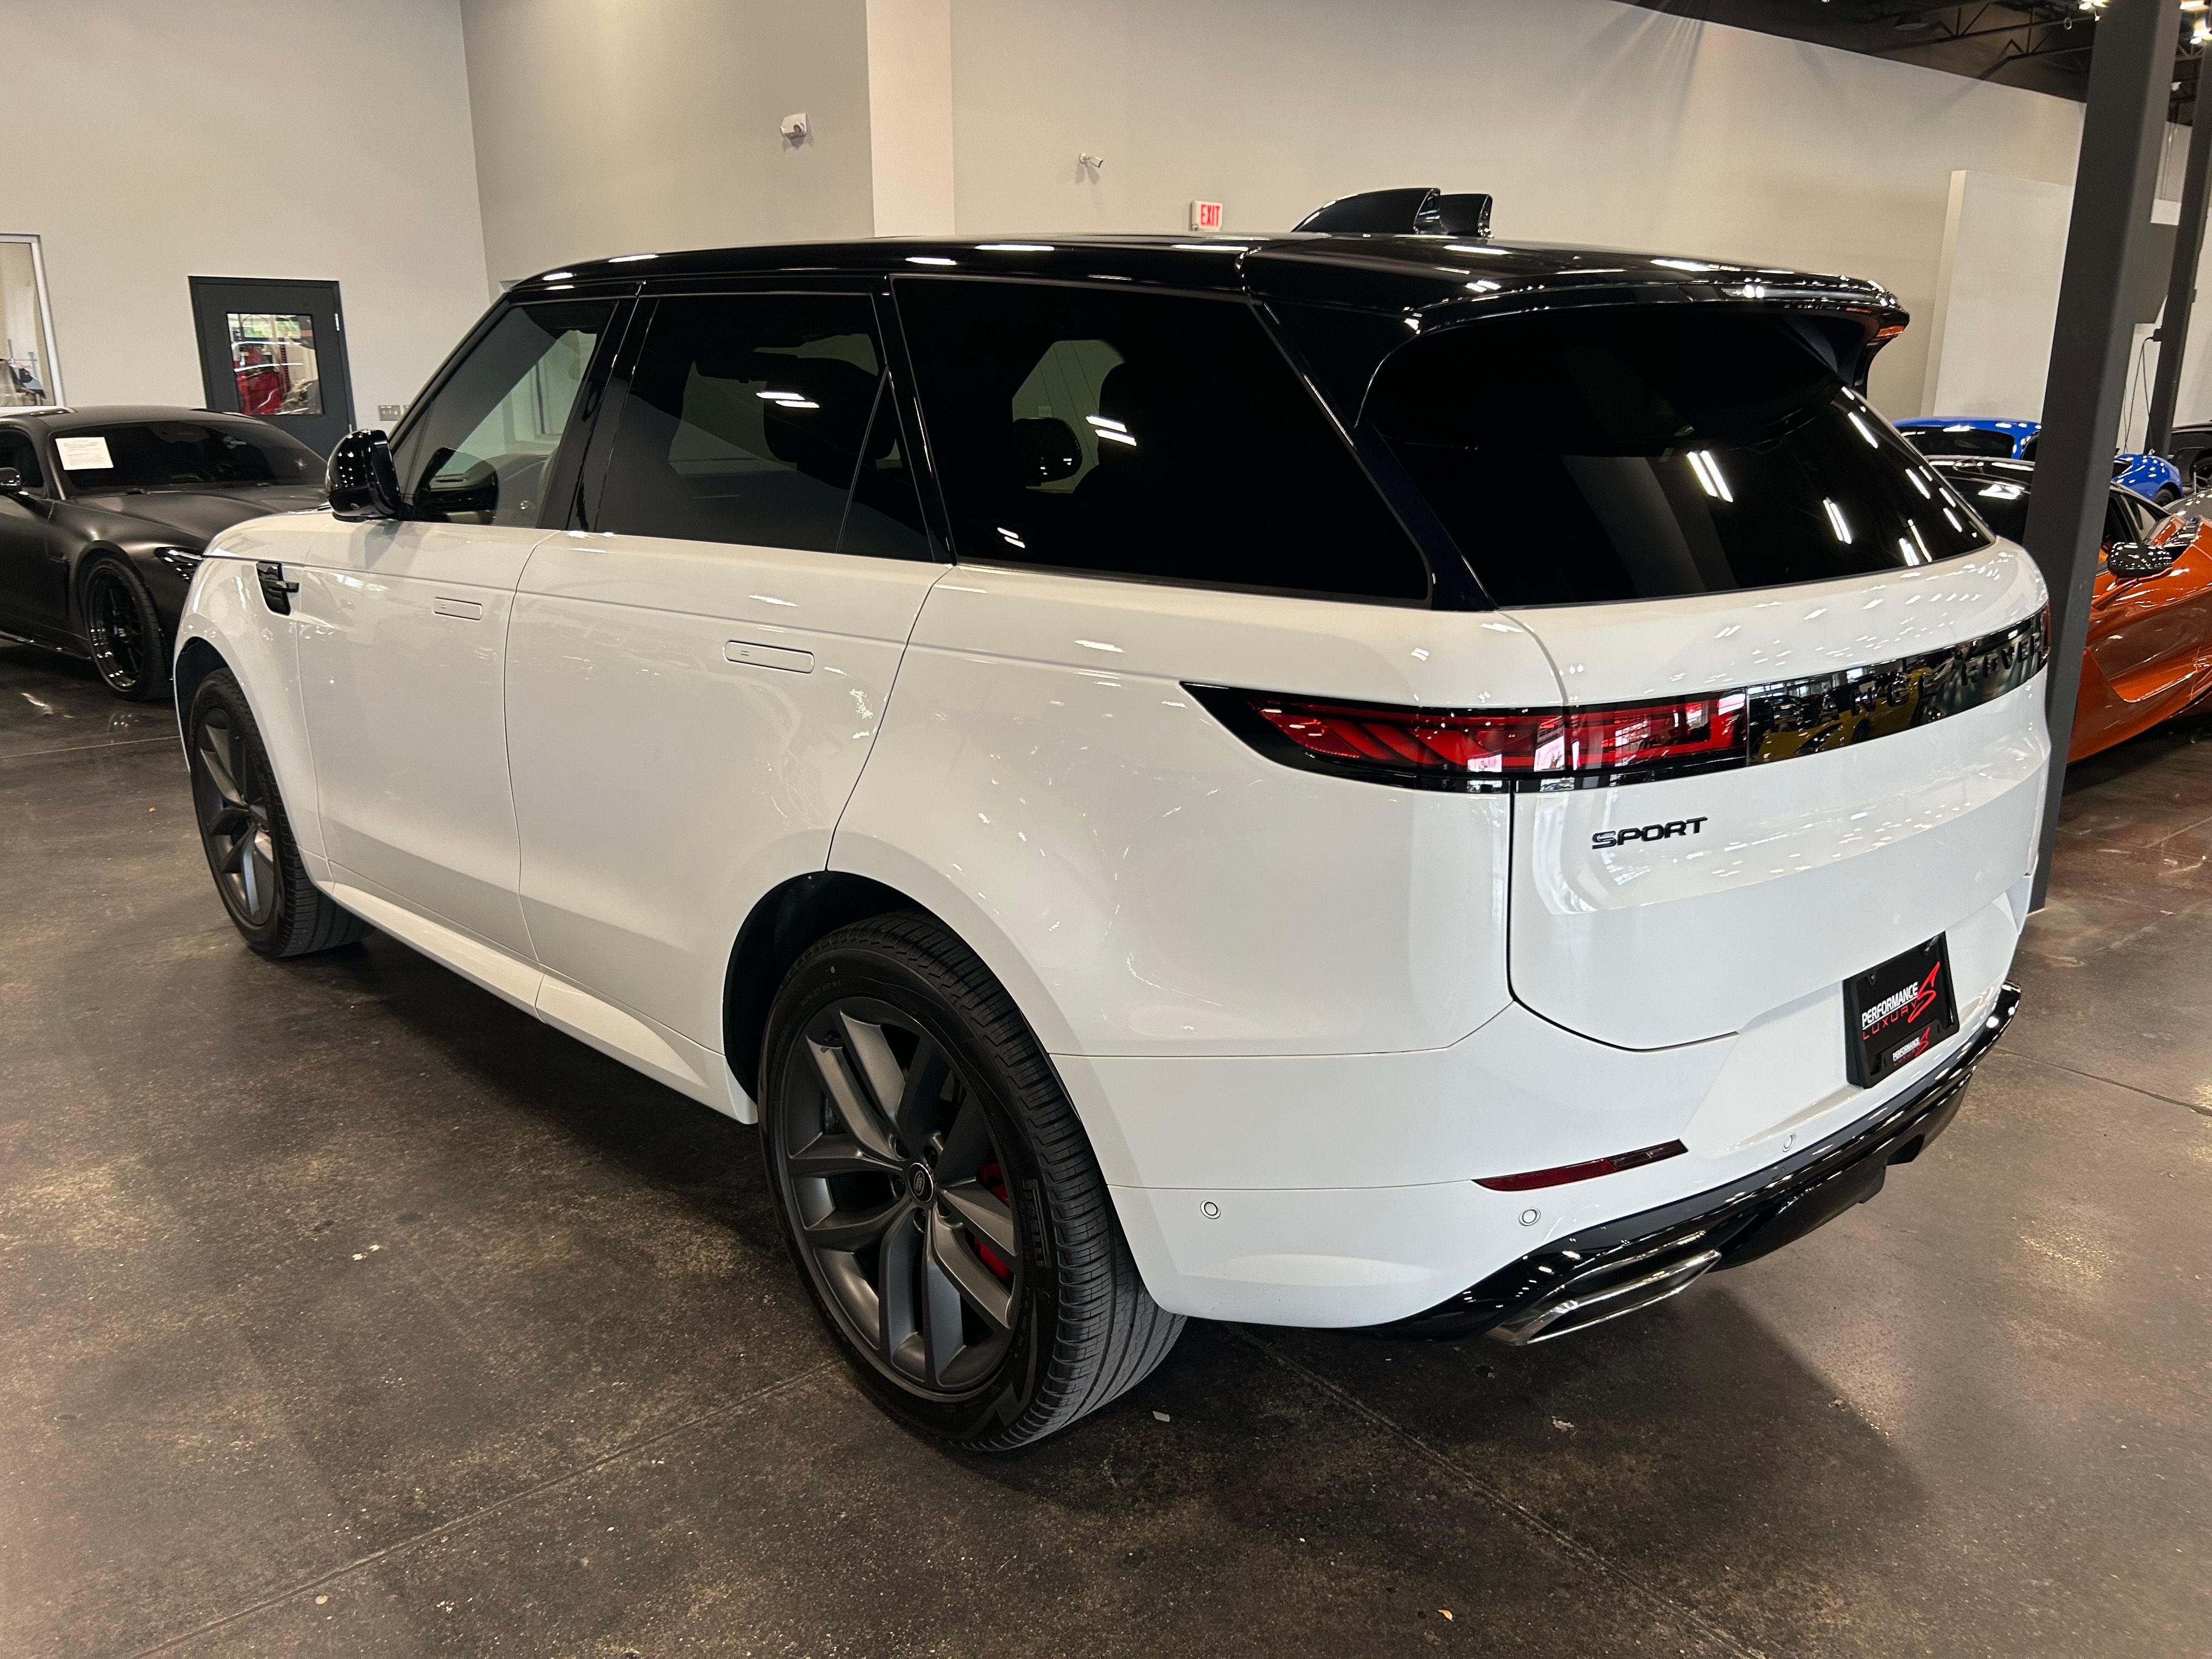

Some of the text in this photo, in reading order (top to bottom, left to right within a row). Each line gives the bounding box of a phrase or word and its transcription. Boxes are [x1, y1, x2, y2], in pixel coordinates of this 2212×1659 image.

[1200, 204, 1220, 227] EXIT
[1592, 816, 1708, 849] SPORT
[1862, 981, 1918, 1028] PERFORMANCE
[1863, 1000, 1918, 1040] LUXURY
